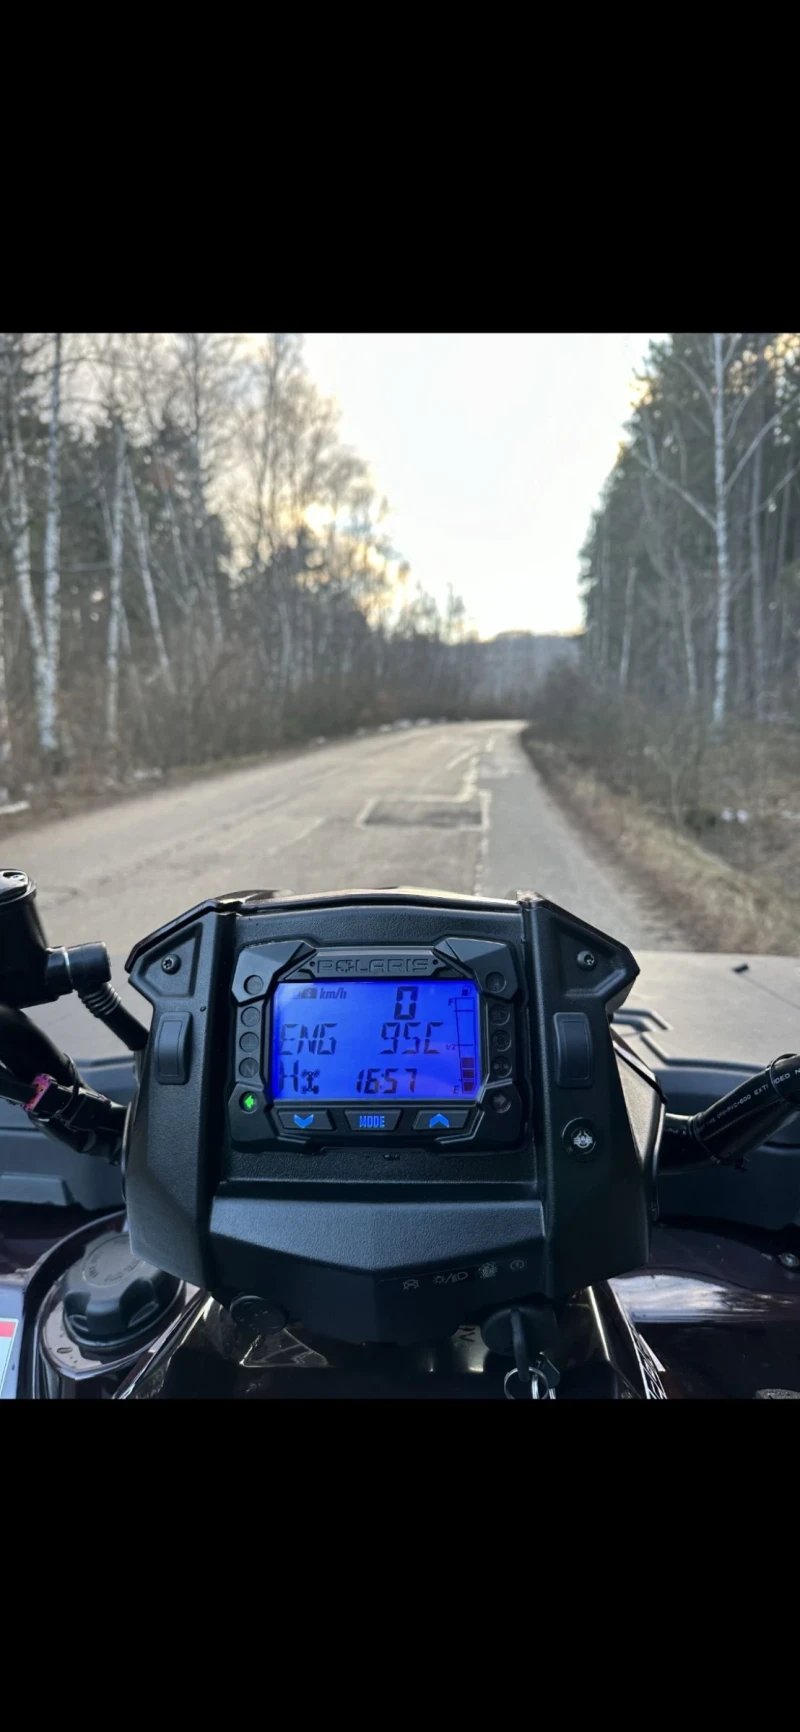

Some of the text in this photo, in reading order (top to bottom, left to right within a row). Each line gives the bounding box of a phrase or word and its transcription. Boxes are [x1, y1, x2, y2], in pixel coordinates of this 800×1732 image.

[317, 958, 429, 974] POLARIS
[319, 987, 348, 999] km/h
[394, 986, 419, 1020] 0
[278, 1022, 444, 1055] ENG 95C
[278, 1060, 418, 1095] H 16:57
[359, 1115, 386, 1129] MODE
